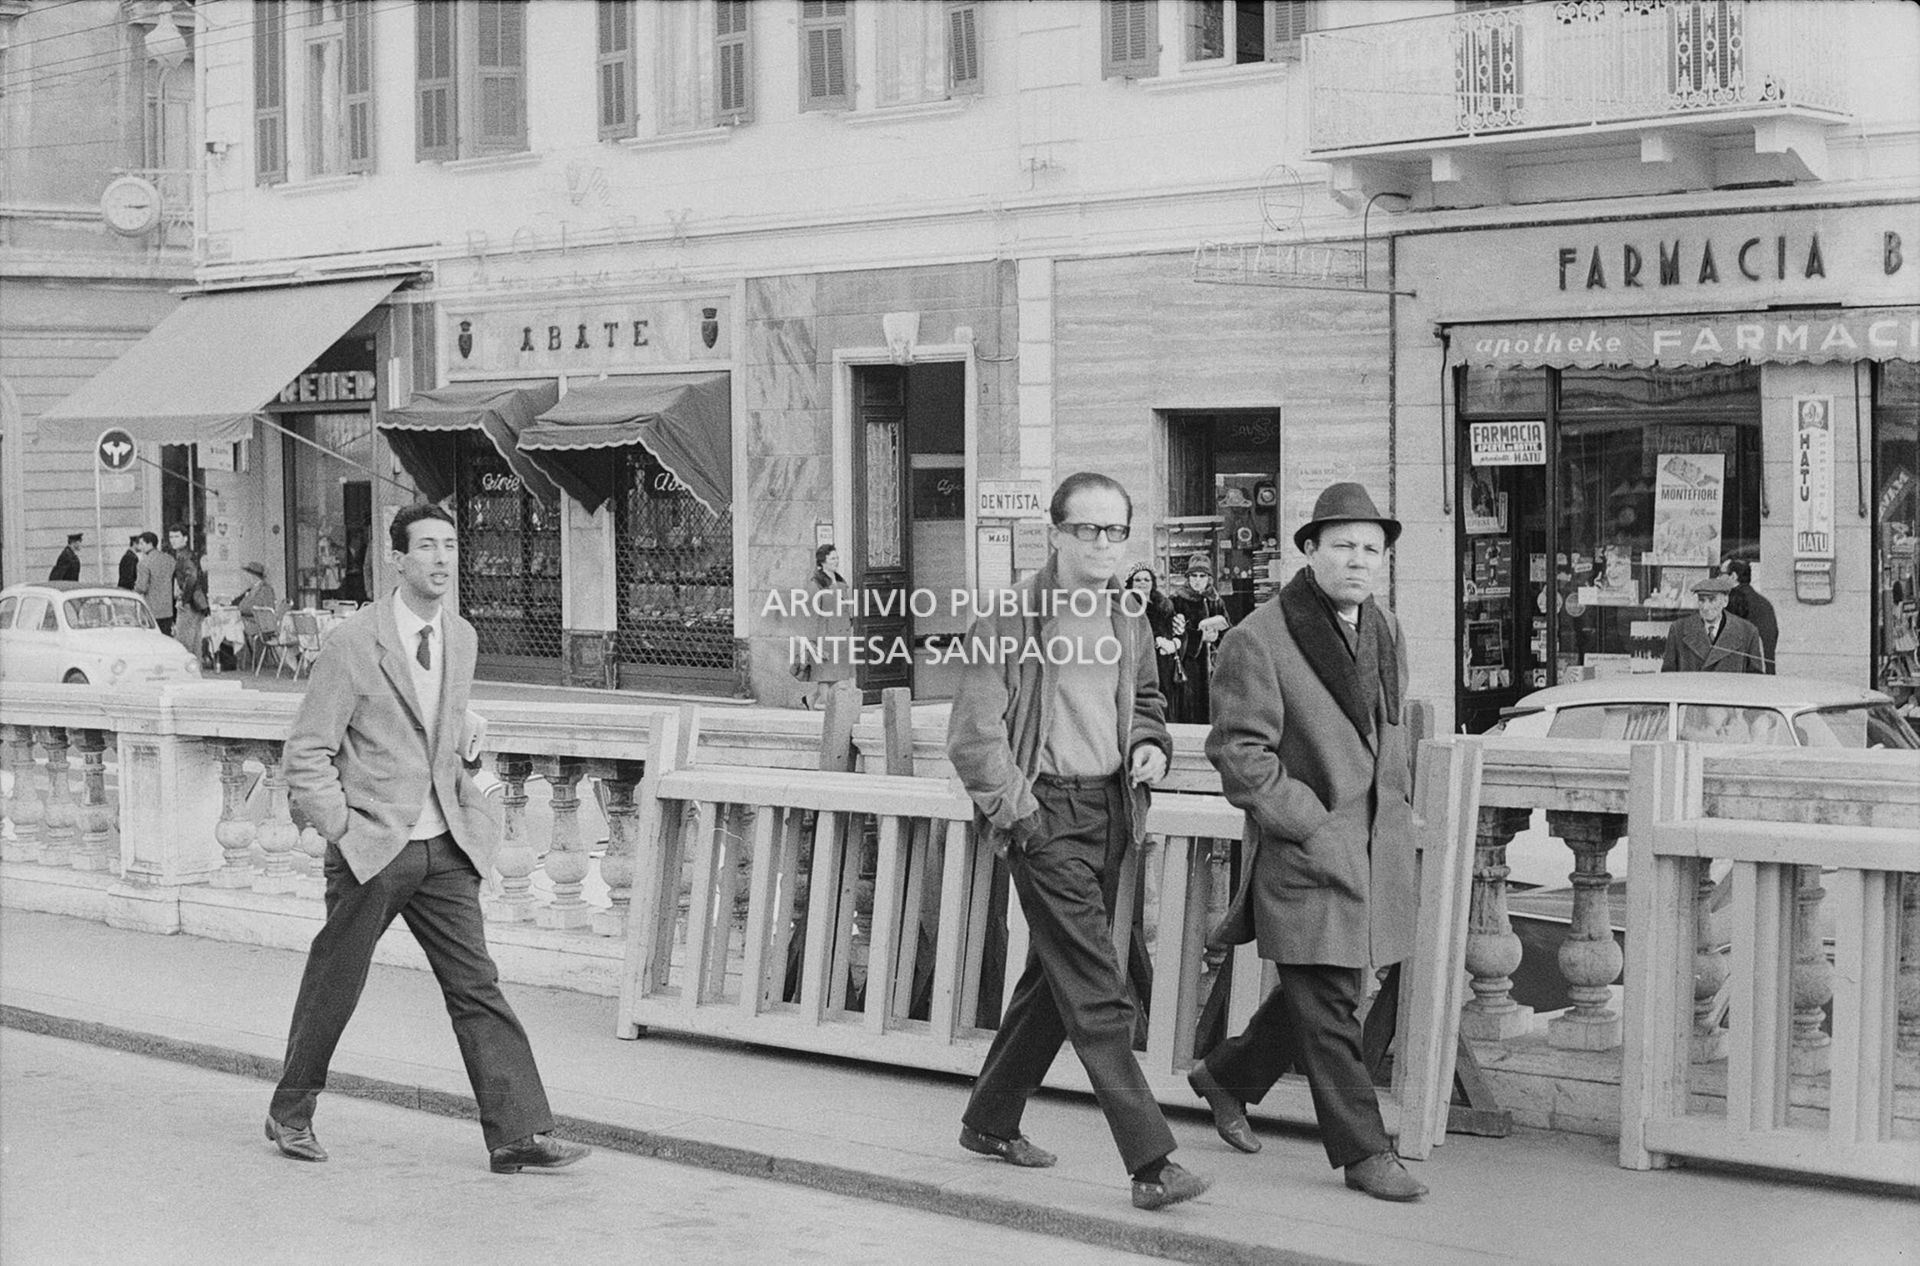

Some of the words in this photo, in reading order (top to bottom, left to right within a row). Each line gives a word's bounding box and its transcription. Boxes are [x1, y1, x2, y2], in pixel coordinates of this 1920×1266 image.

[1558, 231, 1827, 291] FARMACIA
[519, 319, 649, 352] ABATE
[1475, 330, 1621, 358] apotheke
[1473, 424, 1541, 443] FARMACIA
[1800, 433, 1810, 502] HATU
[981, 494, 1040, 511] DENTISTA
[1661, 488, 1718, 500] MONTEFIORE
[1799, 533, 1828, 552] HATU
